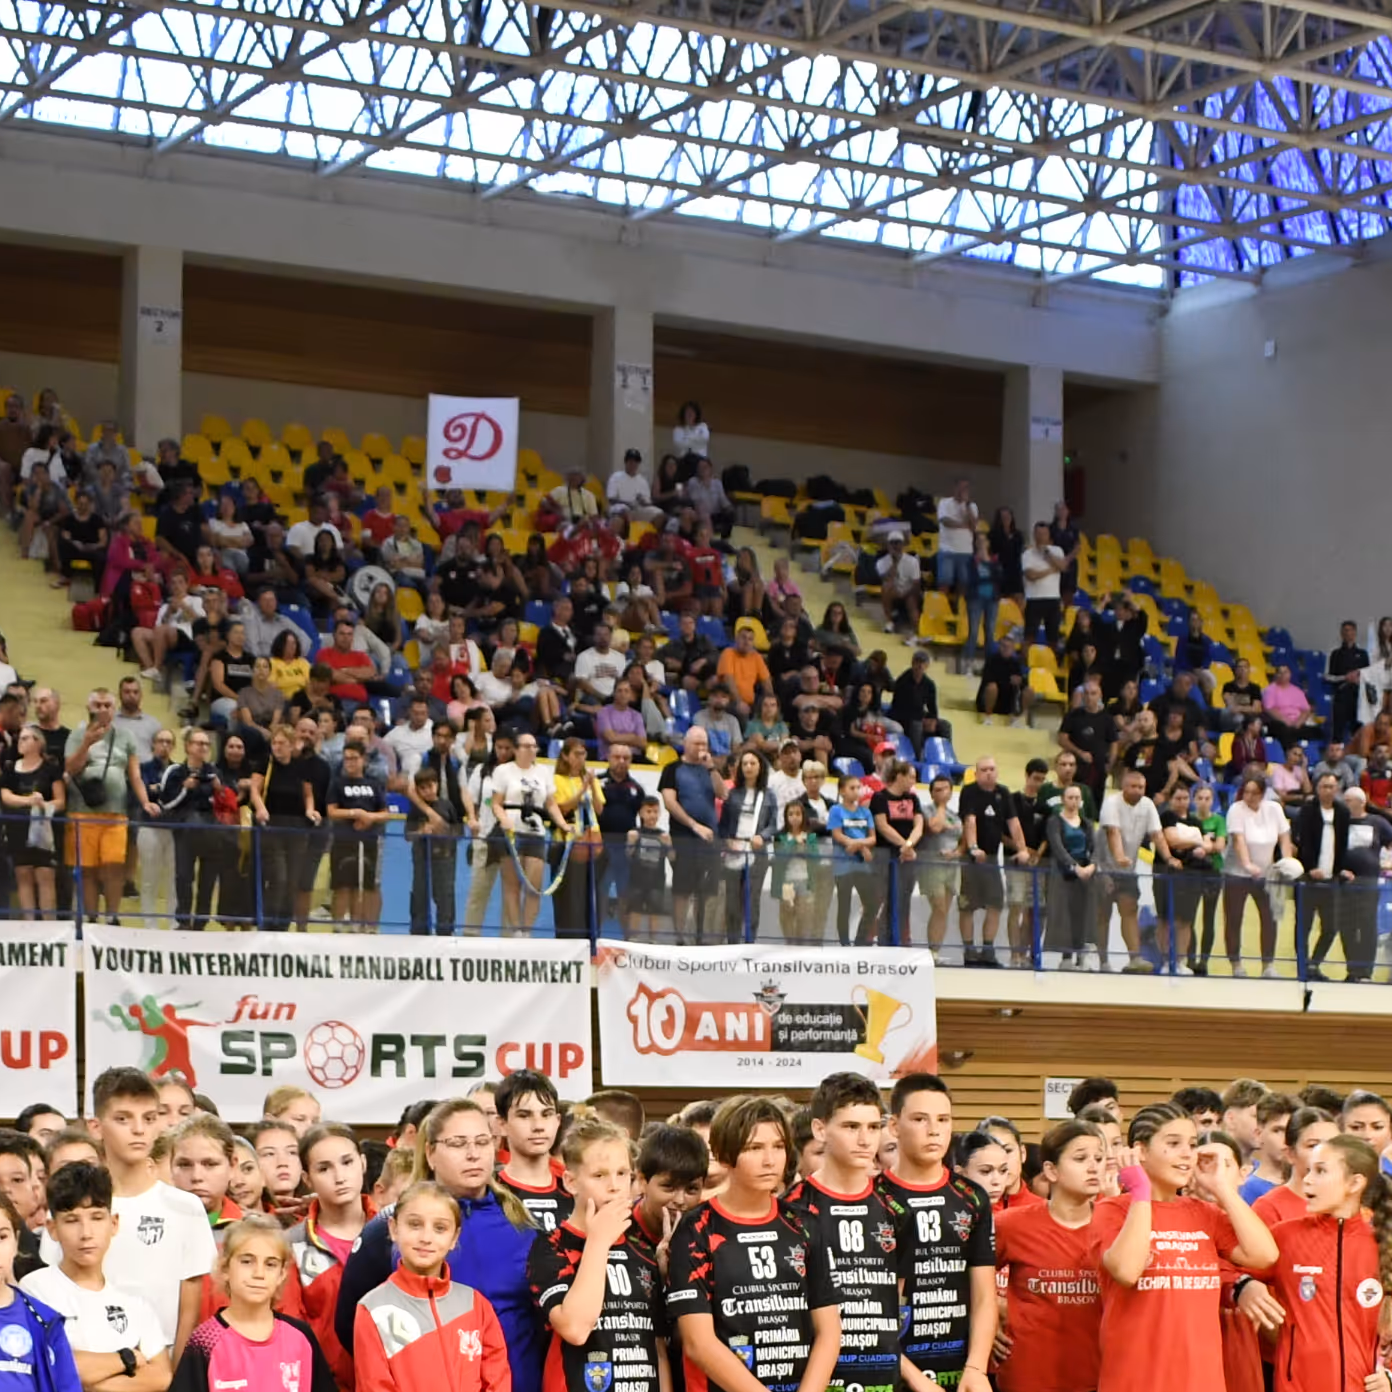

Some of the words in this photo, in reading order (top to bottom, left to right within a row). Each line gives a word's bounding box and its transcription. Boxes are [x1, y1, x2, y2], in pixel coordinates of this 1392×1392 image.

[442, 411, 503, 461] D
[344, 785, 374, 797] BOSS
[90, 945, 164, 974] YOUTH
[170, 949, 333, 979] INTERNATIONAL
[340, 956, 444, 981] HANDBALL
[449, 957, 585, 984] TOURNAMENT
[614, 952, 671, 971] Clubul
[677, 956, 738, 975] Sportiv
[743, 957, 851, 975] Transilvania
[858, 960, 918, 976] Brasov
[225, 994, 297, 1023] fun
[630, 988, 687, 1051] 10
[695, 1011, 764, 1042] ANI
[778, 1013, 792, 1025] de
[495, 1042, 584, 1078] CUP
[737, 1057, 764, 1067] 2014
[776, 1058, 802, 1068] 2024
[1047, 1082, 1076, 1094] SECT
[747, 1245, 777, 1279] 53
[1038, 1269, 1075, 1278] CLUBUL
[732, 1285, 766, 1295] CLUBUL
[1137, 1276, 1171, 1291] ECHIPA
[1173, 1276, 1183, 1289] TA
[913, 1288, 958, 1305] PRIMĂRIA
[754, 1326, 800, 1344] PRIMĂRIA
[914, 1322, 951, 1338] BRAȘOV
[840, 1334, 878, 1351] BRAȘOV
[757, 1363, 794, 1380] BRAȘOV
